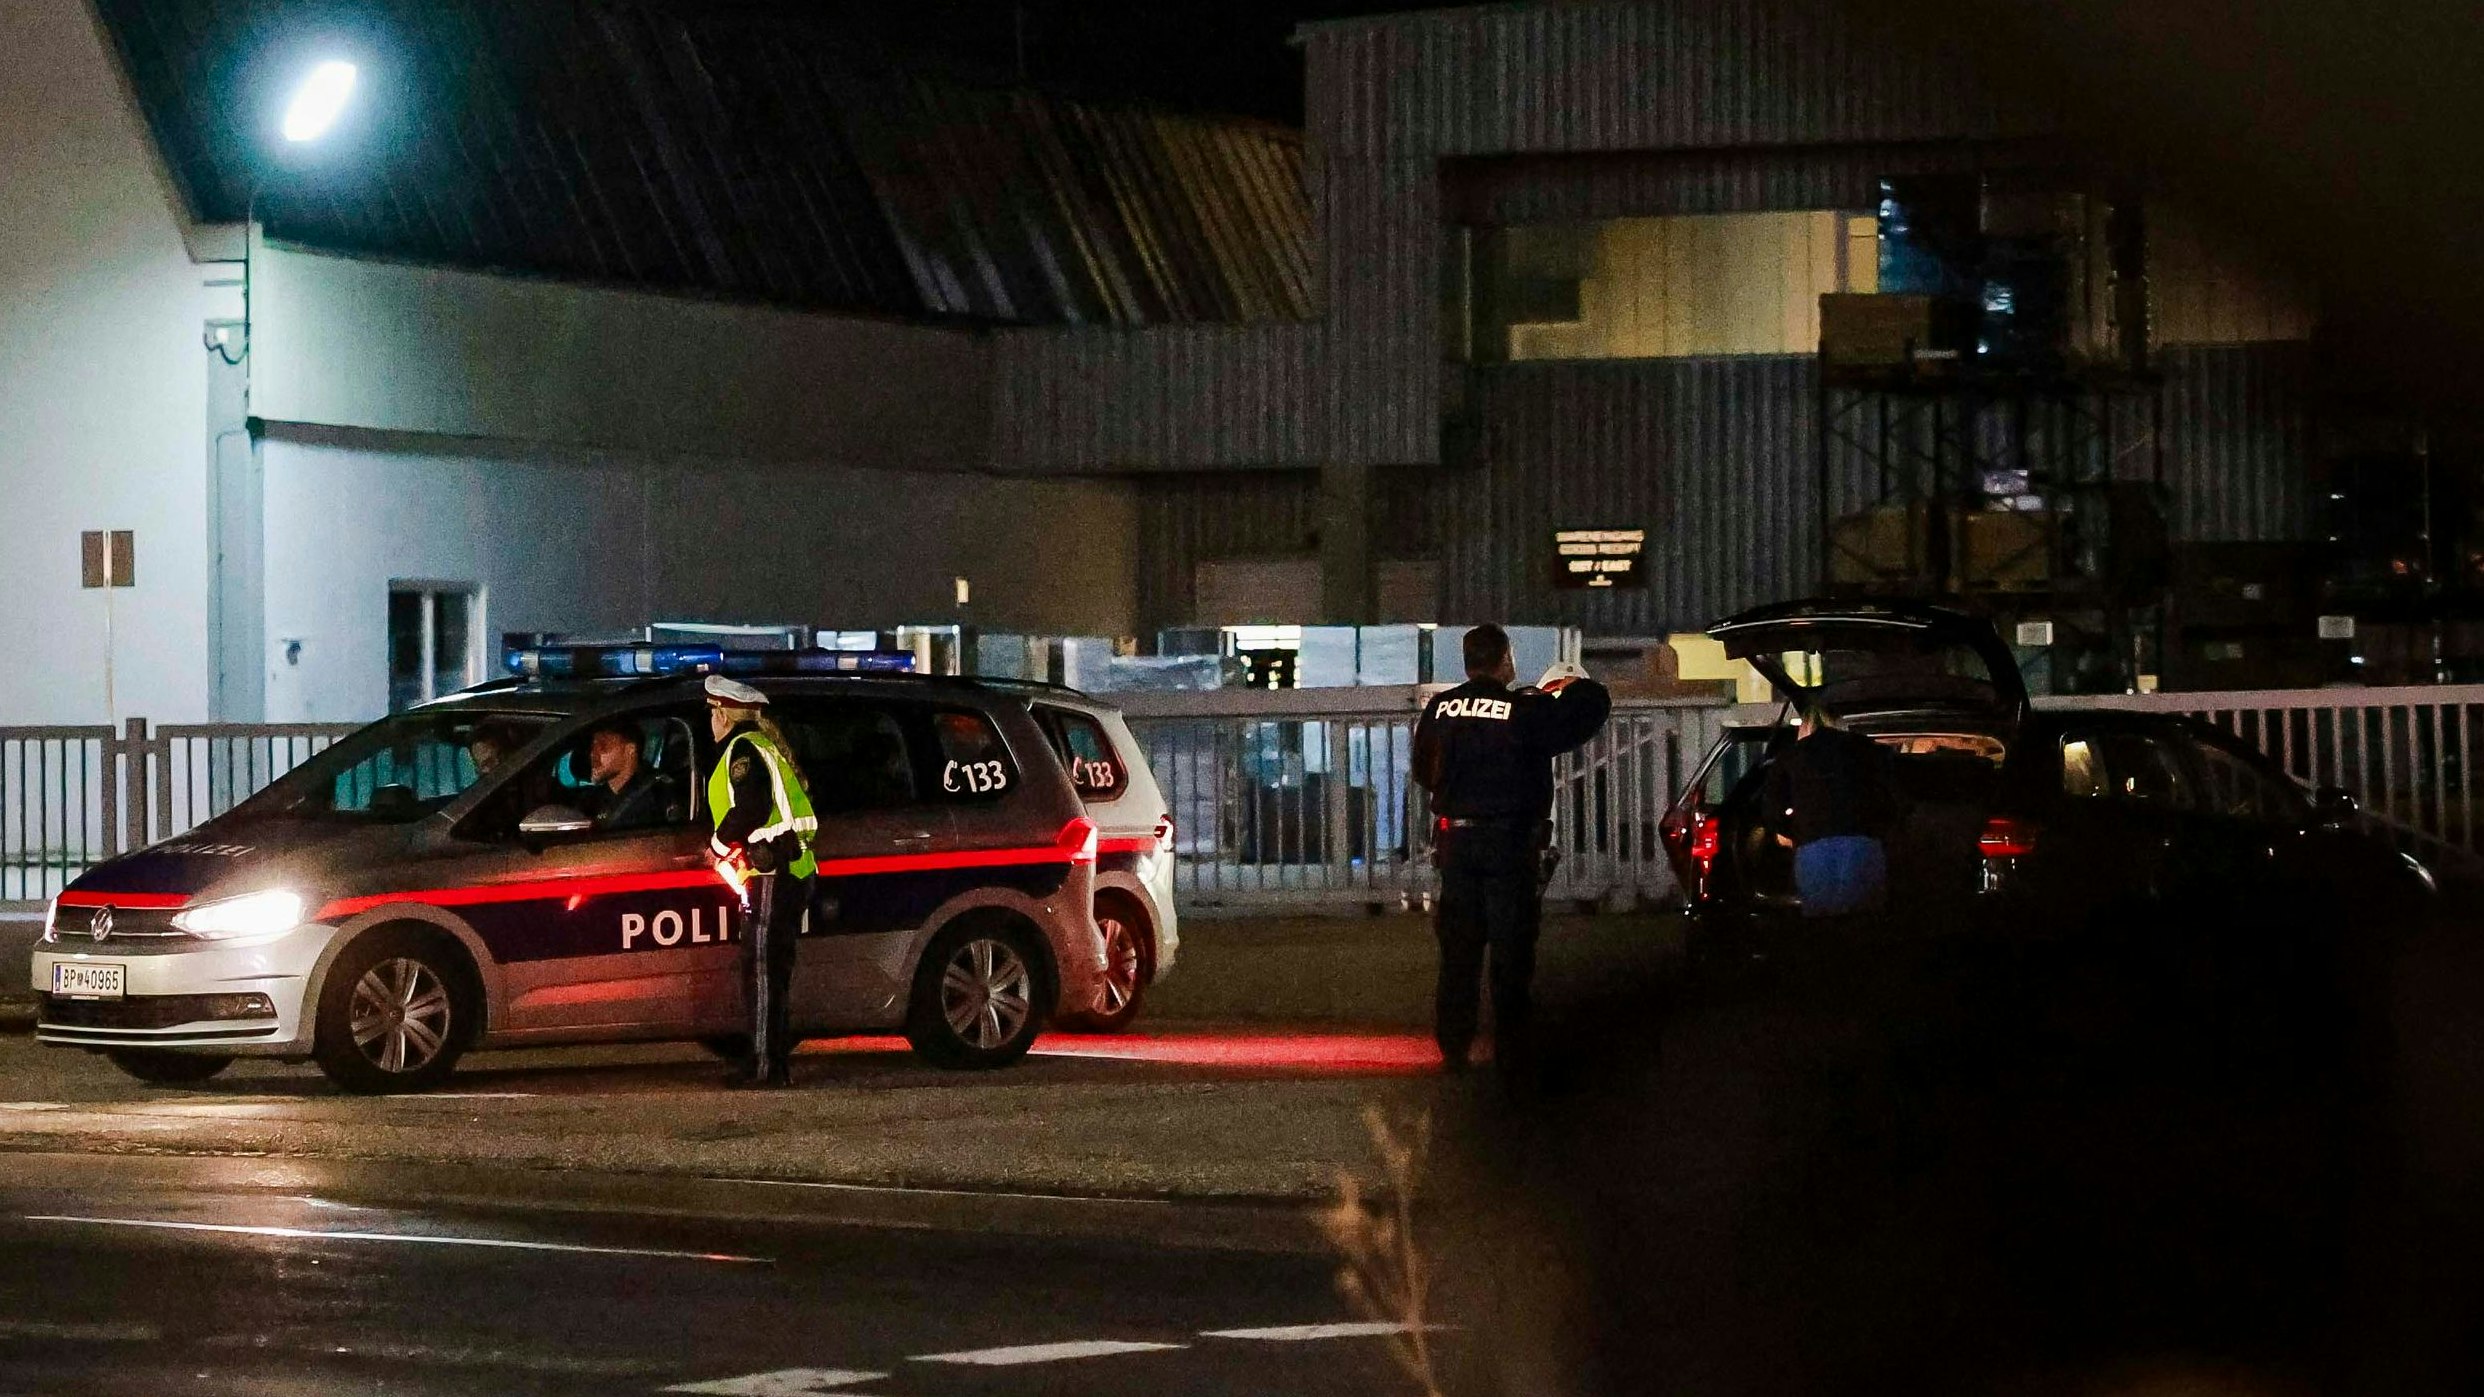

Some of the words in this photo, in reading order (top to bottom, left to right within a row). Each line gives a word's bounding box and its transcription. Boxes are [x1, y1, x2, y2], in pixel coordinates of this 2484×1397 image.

[1435, 698, 1512, 720] POLIZEI
[962, 760, 1006, 792] 133
[1084, 761, 1114, 787] 133
[622, 906, 809, 949] POLII
[84, 969, 119, 990] 40965
